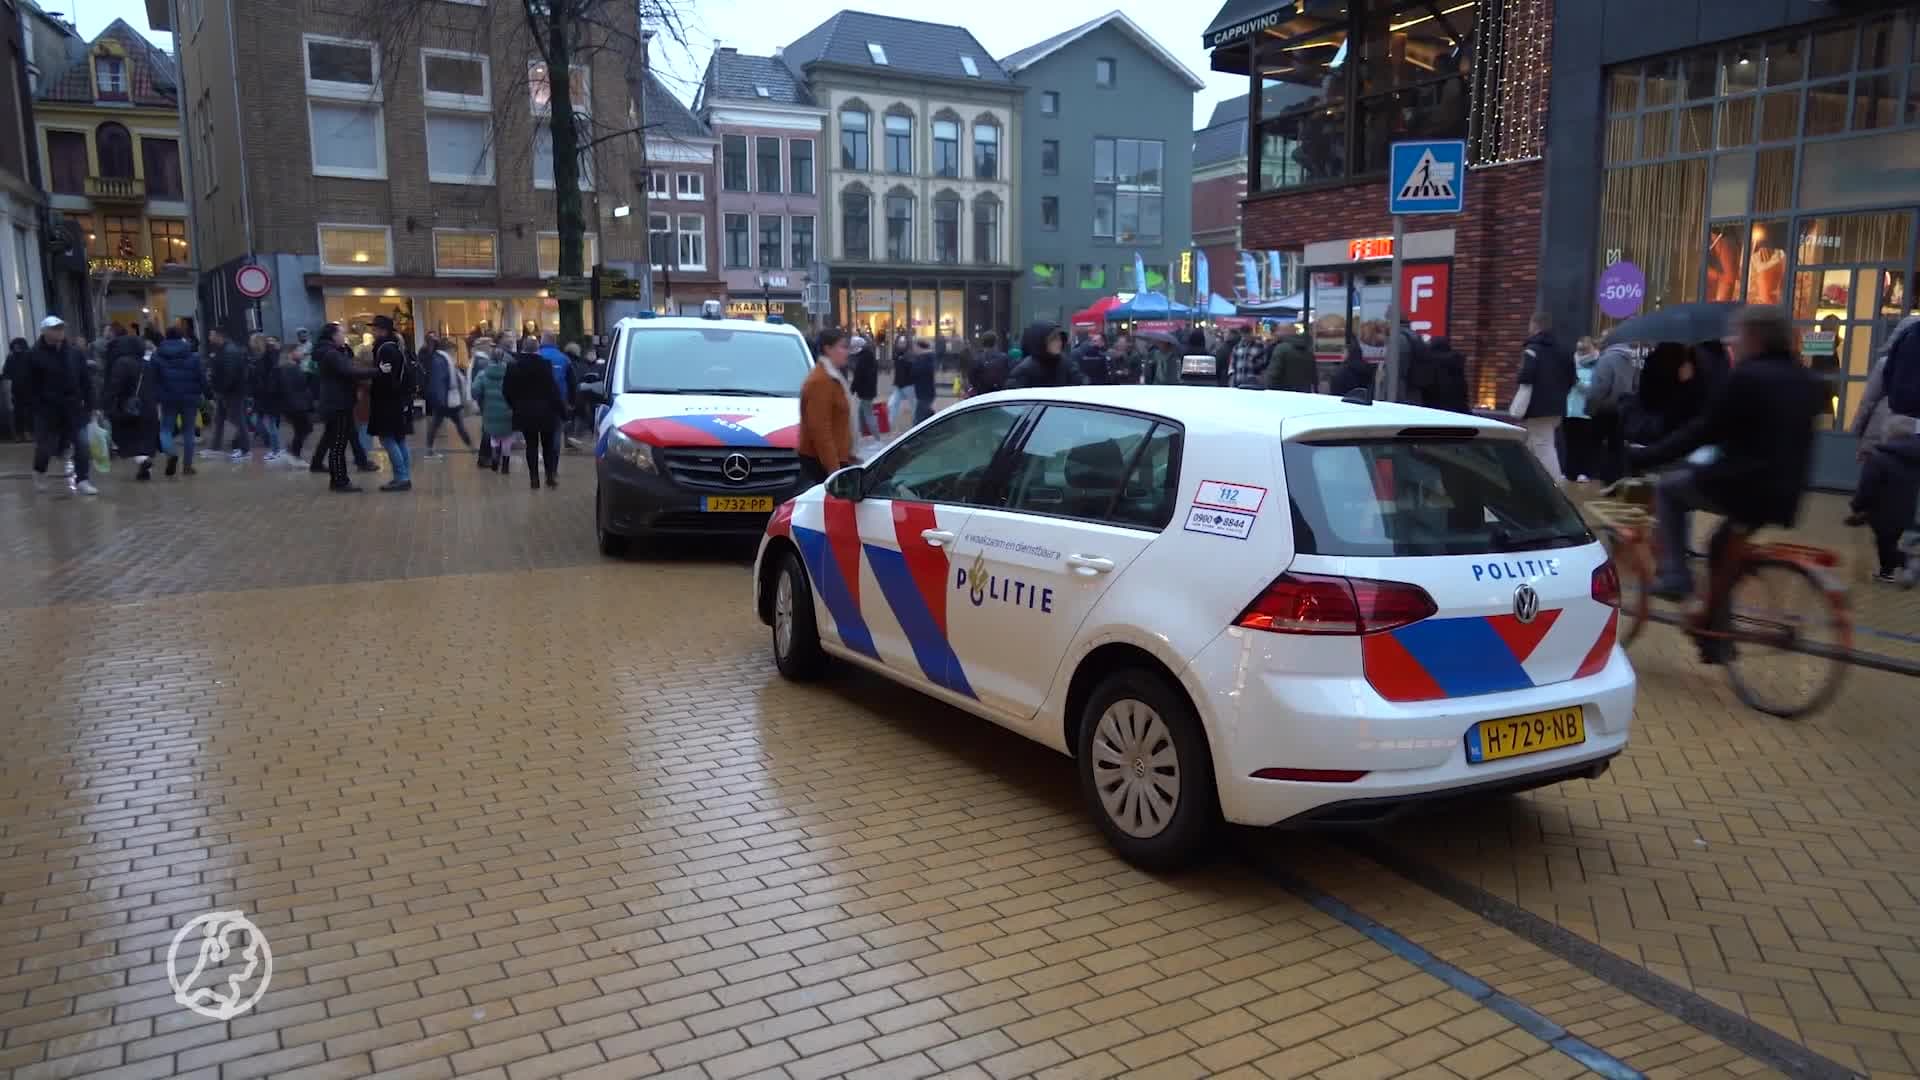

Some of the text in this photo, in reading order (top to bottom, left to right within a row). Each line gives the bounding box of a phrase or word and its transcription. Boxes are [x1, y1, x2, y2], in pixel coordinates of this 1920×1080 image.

[1215, 14, 1277, 44] CAPPUVINO
[1600, 283, 1642, 299] -50%
[713, 499, 766, 510] J-732-PP
[1193, 514, 1213, 524] 0900
[1223, 517, 1246, 529] 8844
[1472, 560, 1559, 581] POLITIE
[1487, 713, 1577, 753] H-729-NB
